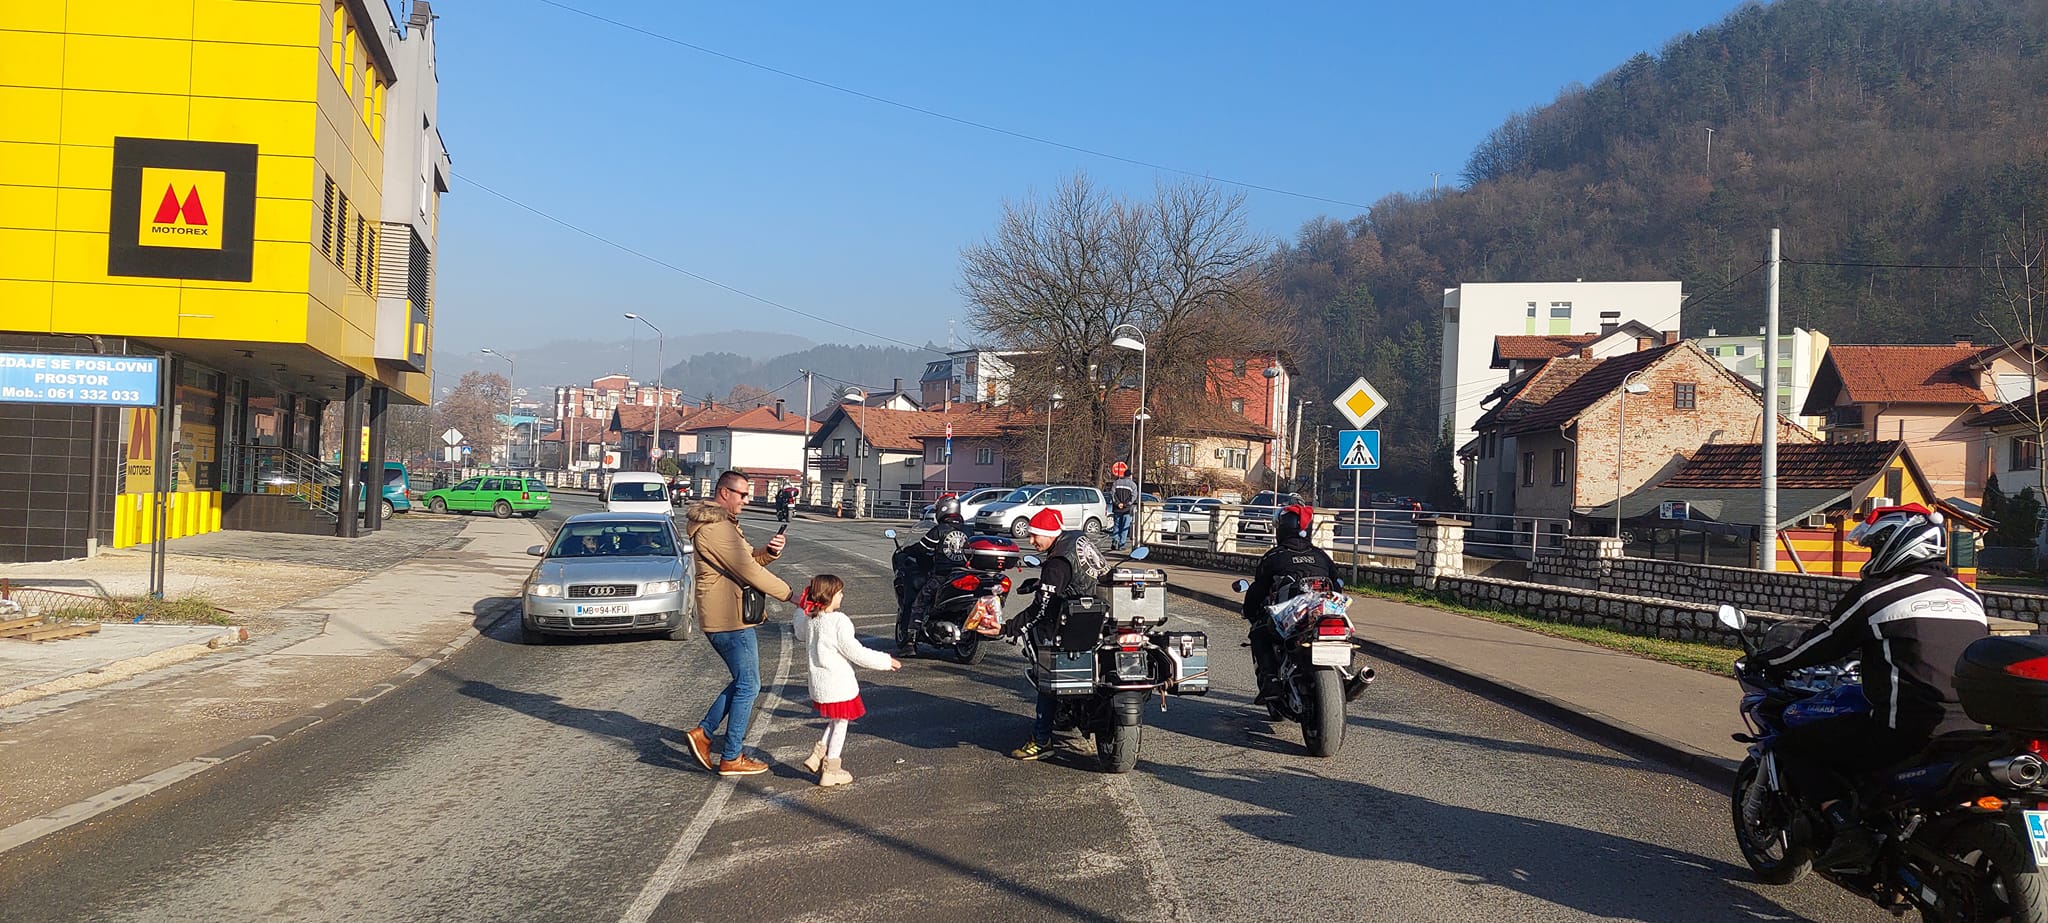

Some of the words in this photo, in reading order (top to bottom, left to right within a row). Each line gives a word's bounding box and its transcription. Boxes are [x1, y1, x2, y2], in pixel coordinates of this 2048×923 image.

[152, 226, 208, 235] MOTOREX
[50, 359, 71, 370] SE
[75, 360, 153, 372] POSLOVNI
[34, 374, 109, 385] PROSTOR
[2, 386, 43, 398] Mob.:
[47, 388, 74, 399] 061
[79, 389, 107, 401] 332
[111, 390, 139, 401] 033
[127, 465, 151, 476] MOTOREX
